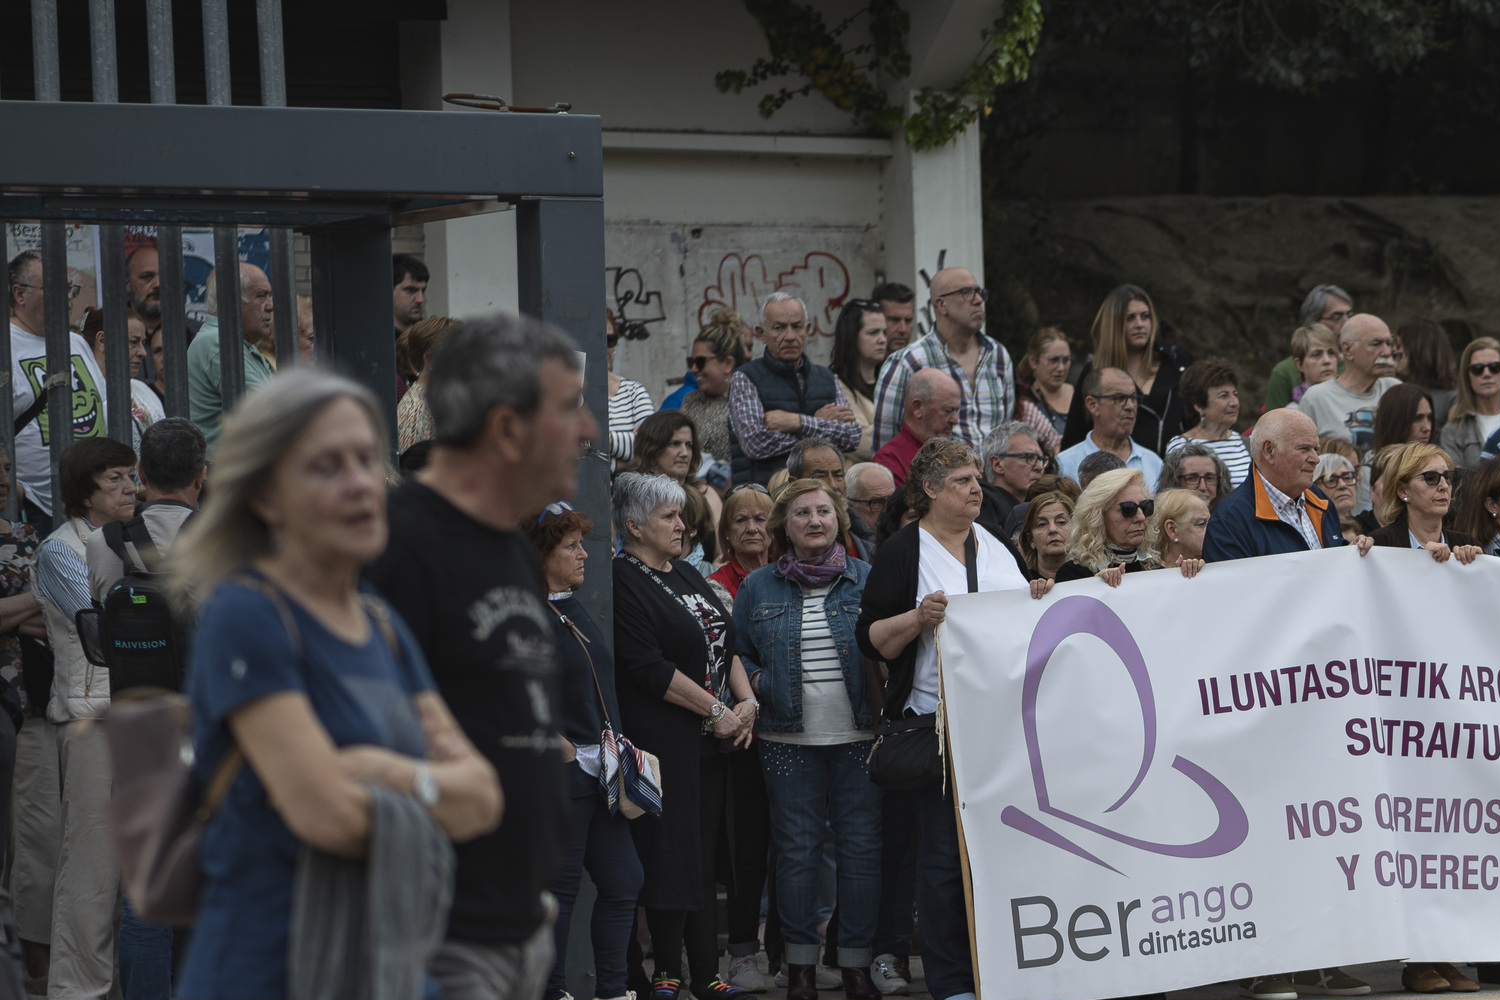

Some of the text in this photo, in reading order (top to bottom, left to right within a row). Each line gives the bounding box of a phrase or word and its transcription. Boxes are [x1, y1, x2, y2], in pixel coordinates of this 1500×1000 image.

[114, 639, 167, 649] HAIVISION
[1285, 796, 1363, 840] NOS
[1336, 854, 1360, 891] Y
[1138, 921, 1257, 956] dintasuna
